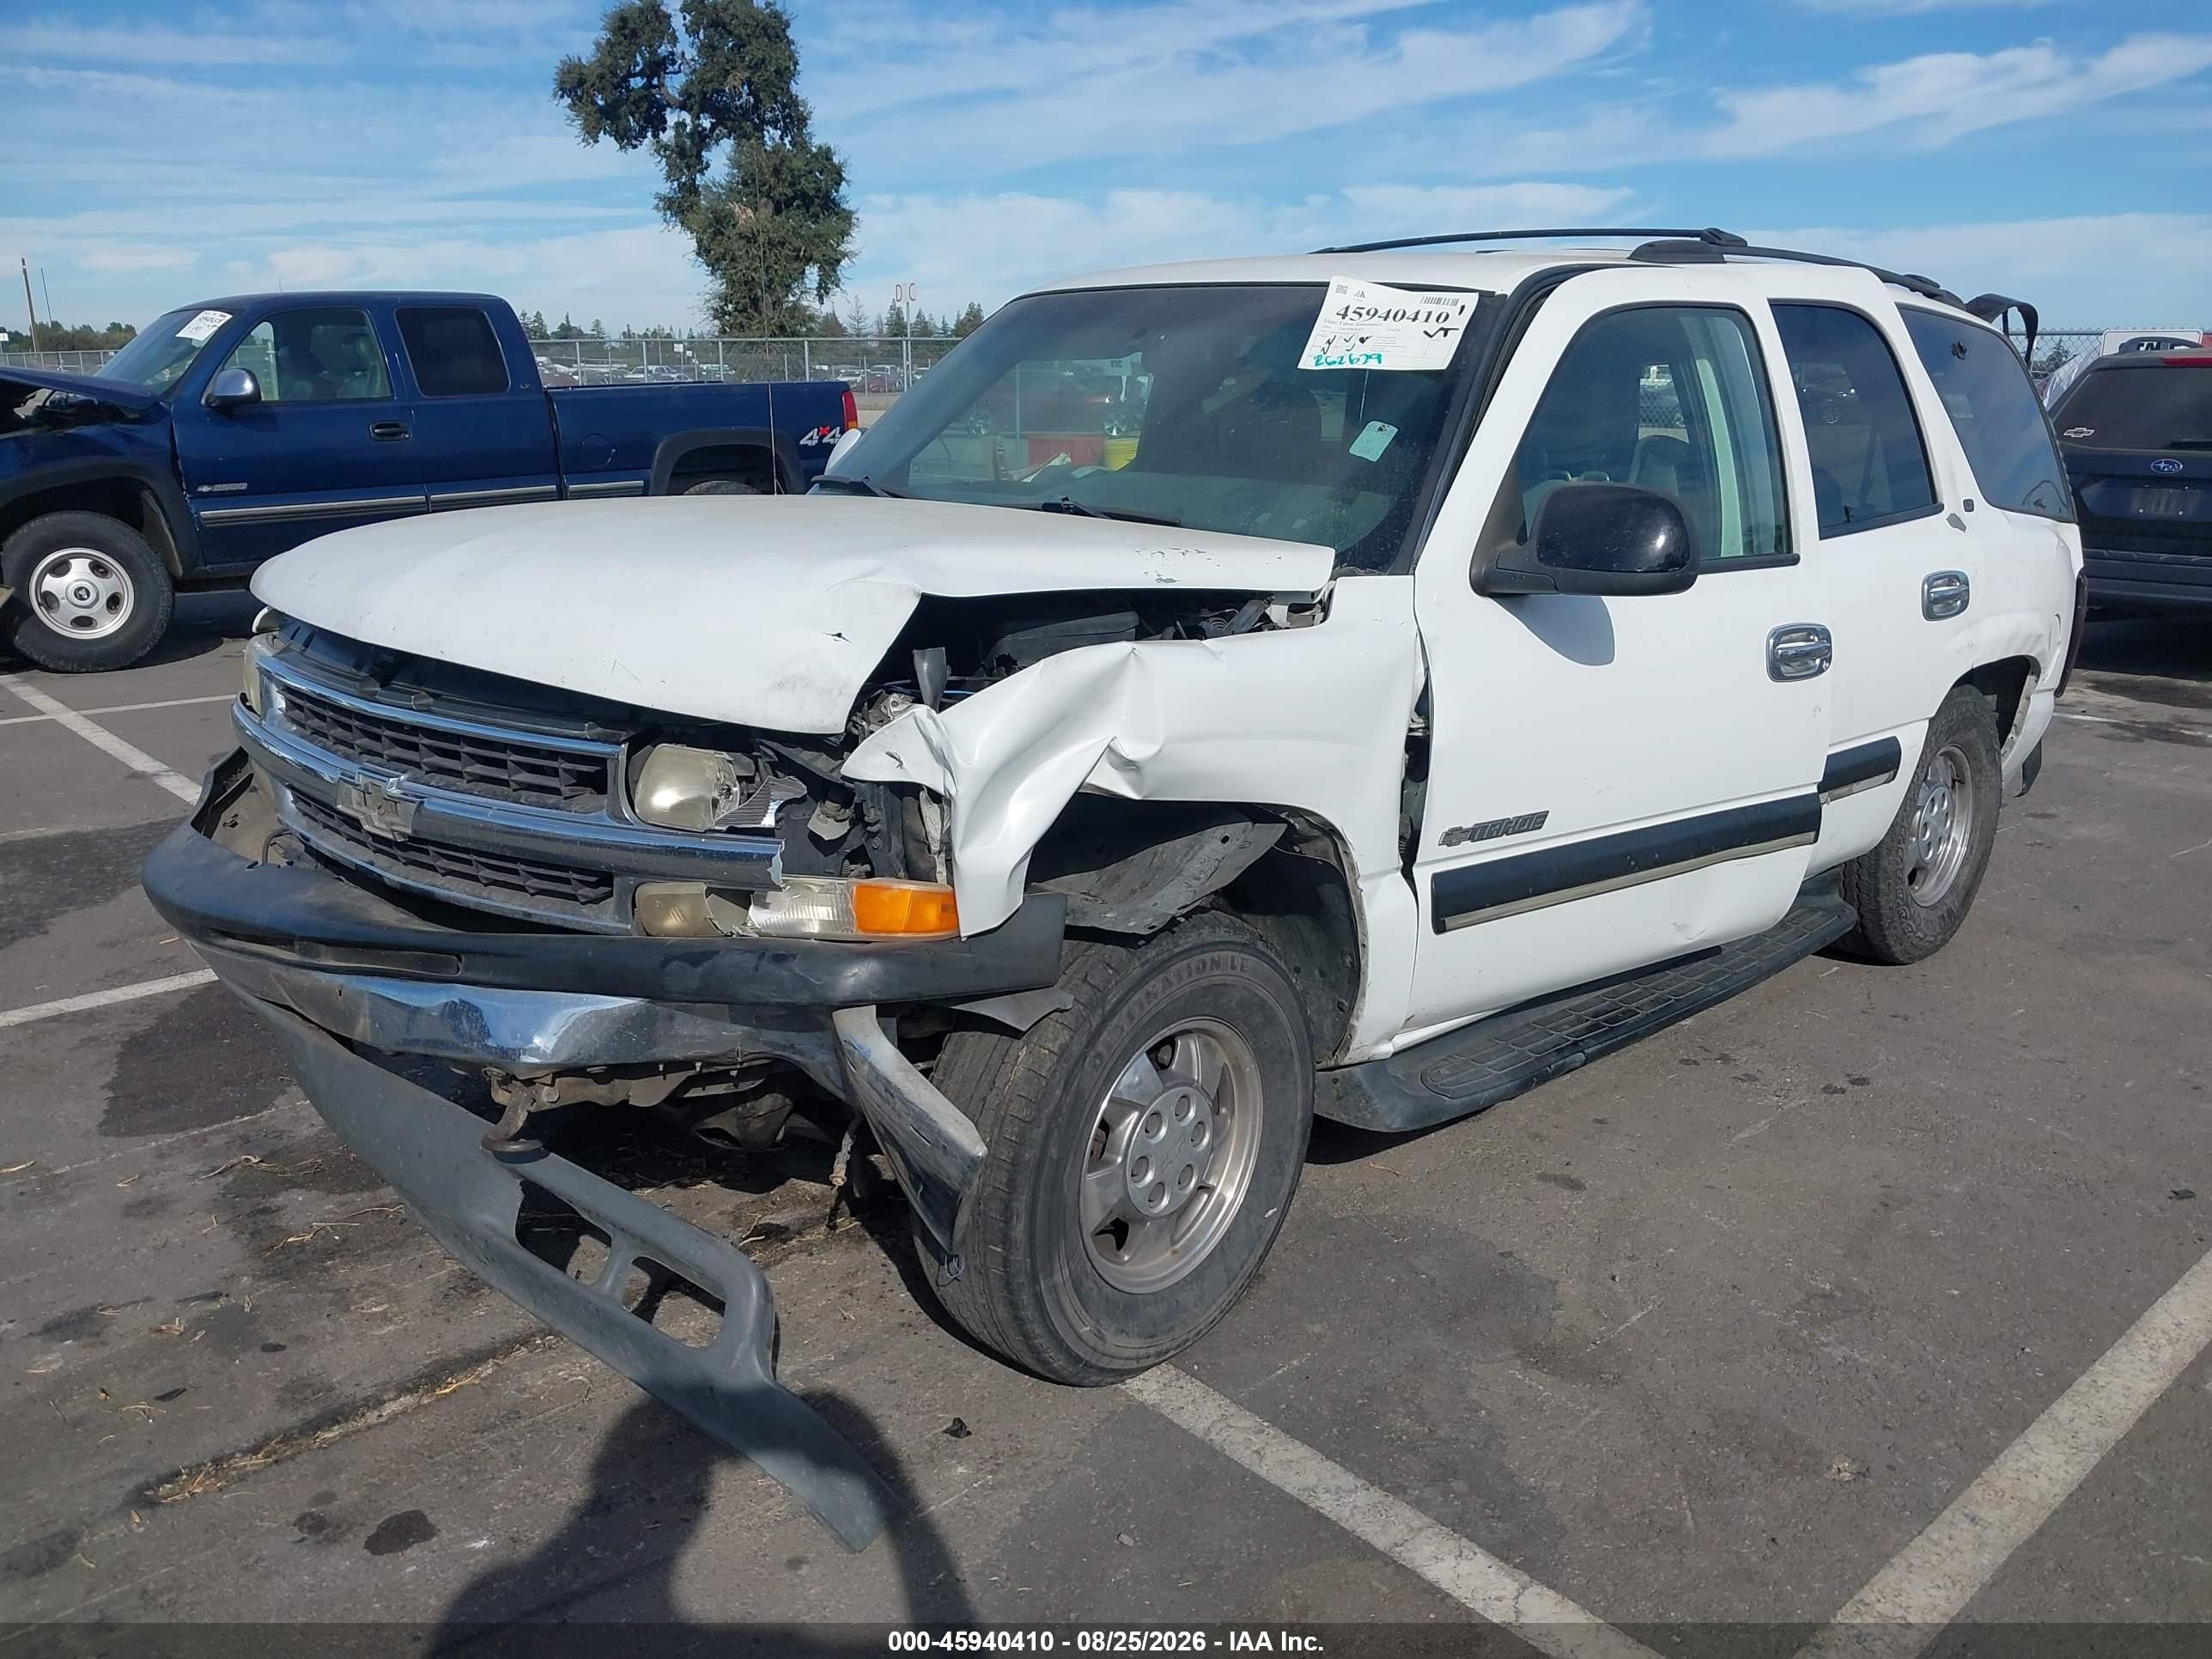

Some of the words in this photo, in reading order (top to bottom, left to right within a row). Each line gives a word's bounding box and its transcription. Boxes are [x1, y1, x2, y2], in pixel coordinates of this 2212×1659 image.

[896, 284, 902, 301] D
[909, 283, 915, 301] C
[1335, 304, 1450, 324] 45940410
[1470, 810, 1550, 842] TAHOE
